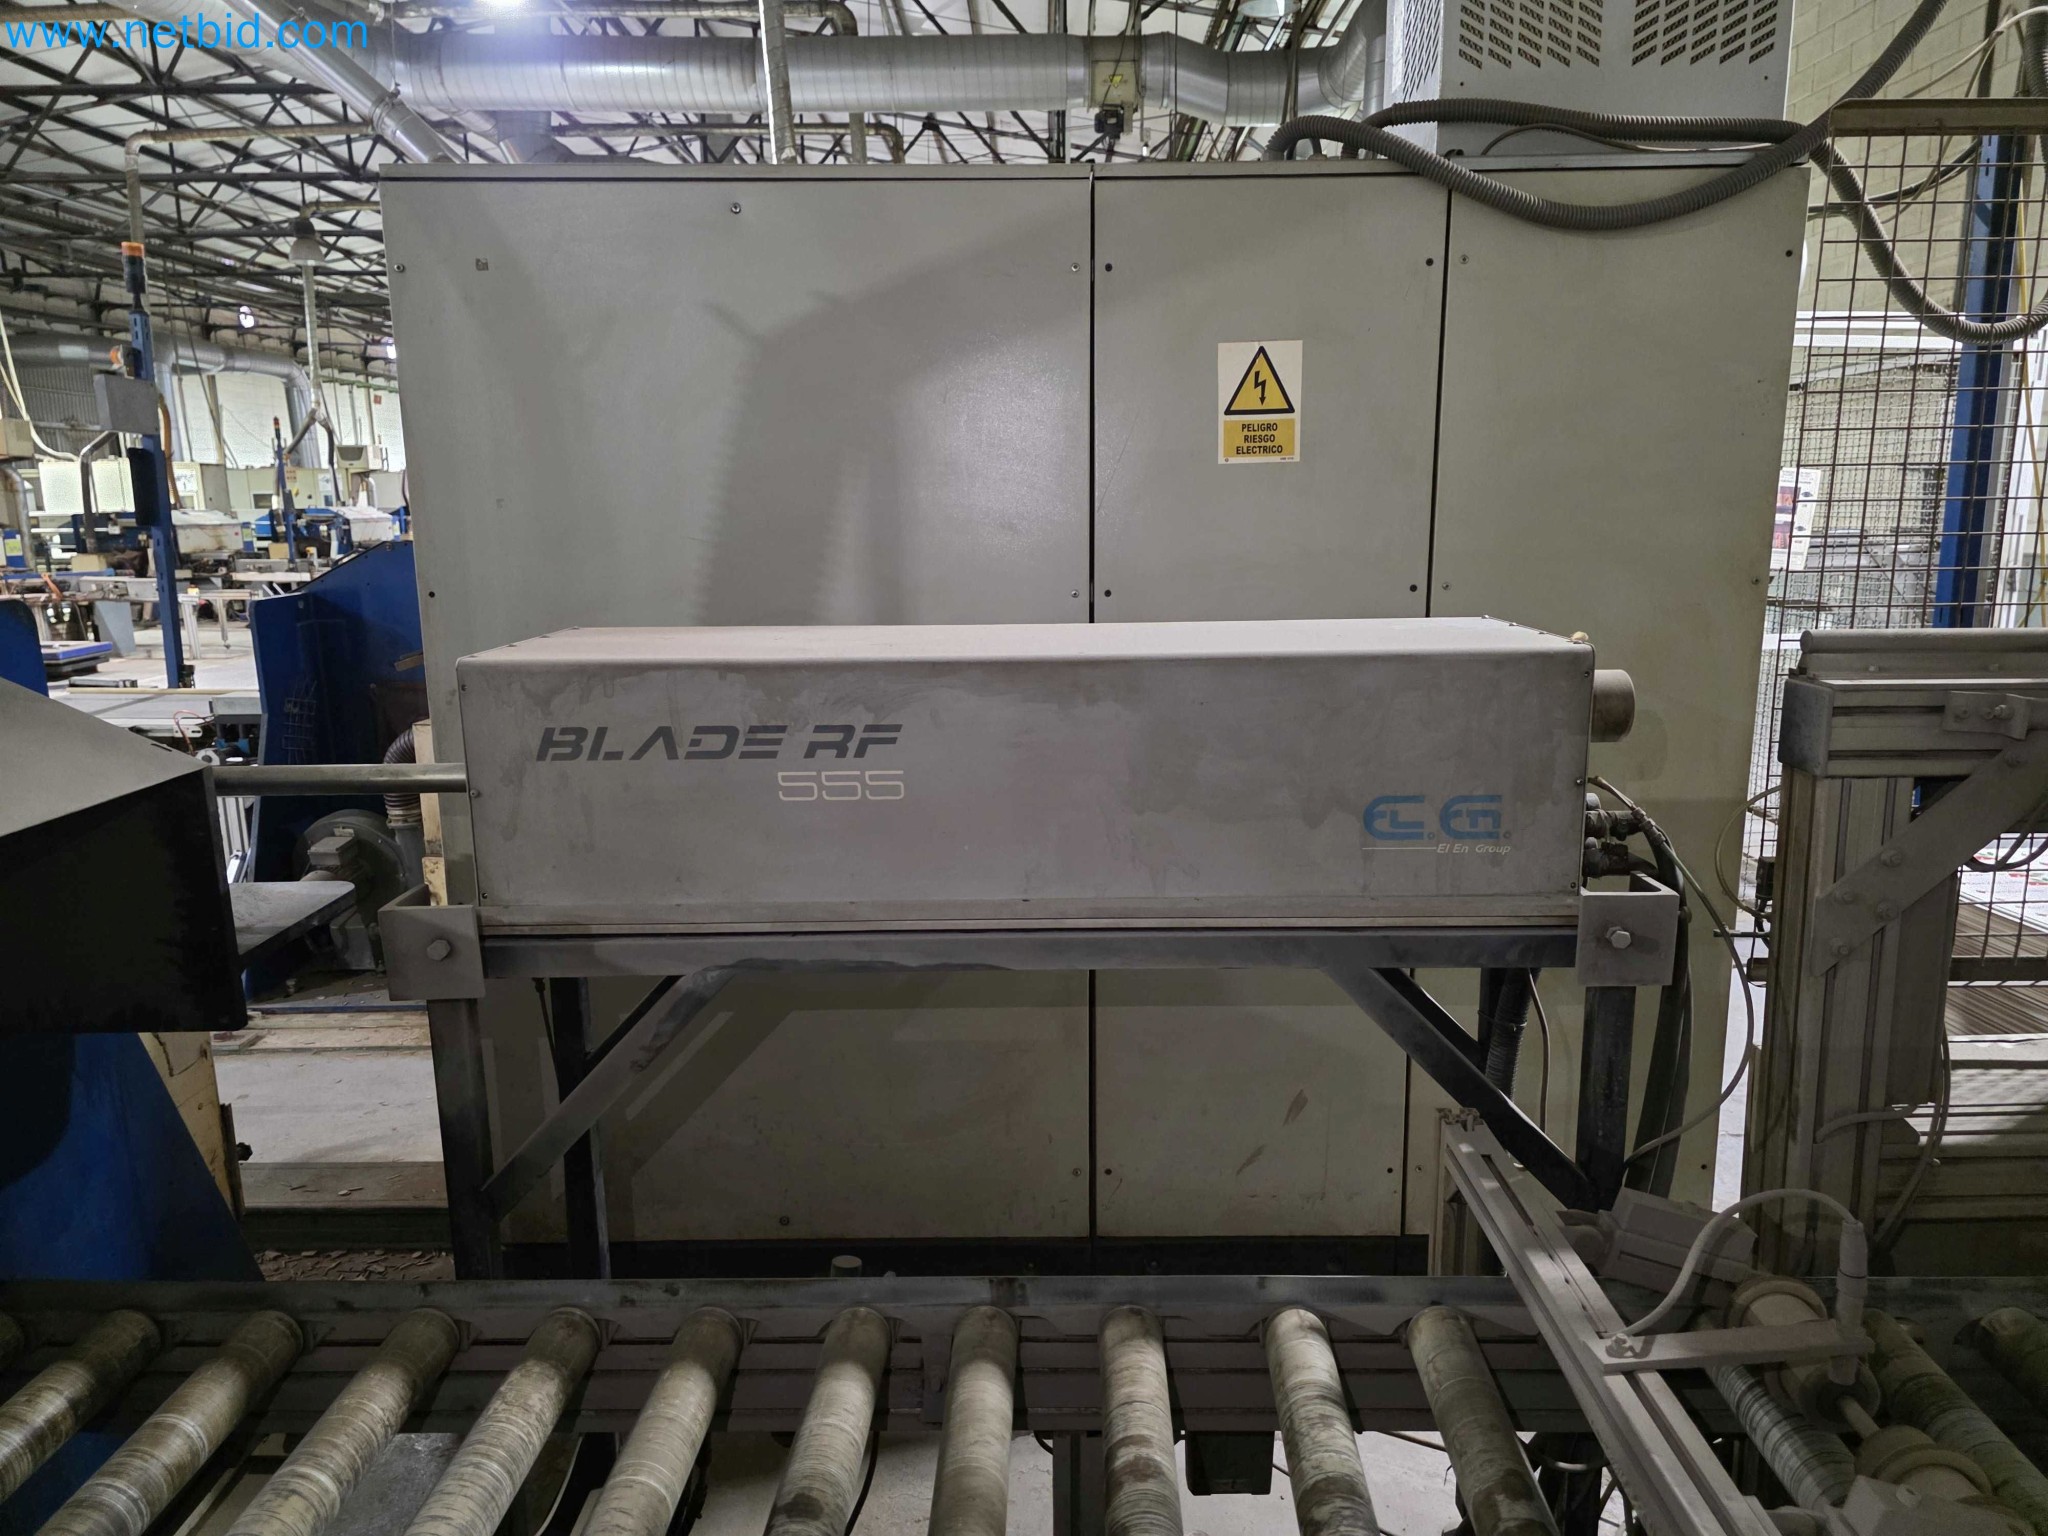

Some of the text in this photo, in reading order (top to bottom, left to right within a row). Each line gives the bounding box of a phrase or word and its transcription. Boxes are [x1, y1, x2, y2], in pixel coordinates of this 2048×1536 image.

[1241, 422, 1278, 433] PELIGRO
[1243, 433, 1276, 444] RIESGO
[1236, 445, 1283, 455] ELECTRICO
[536, 724, 903, 761] BLADE RF
[777, 771, 904, 801] 555
[1437, 843, 1511, 855] El En Group
